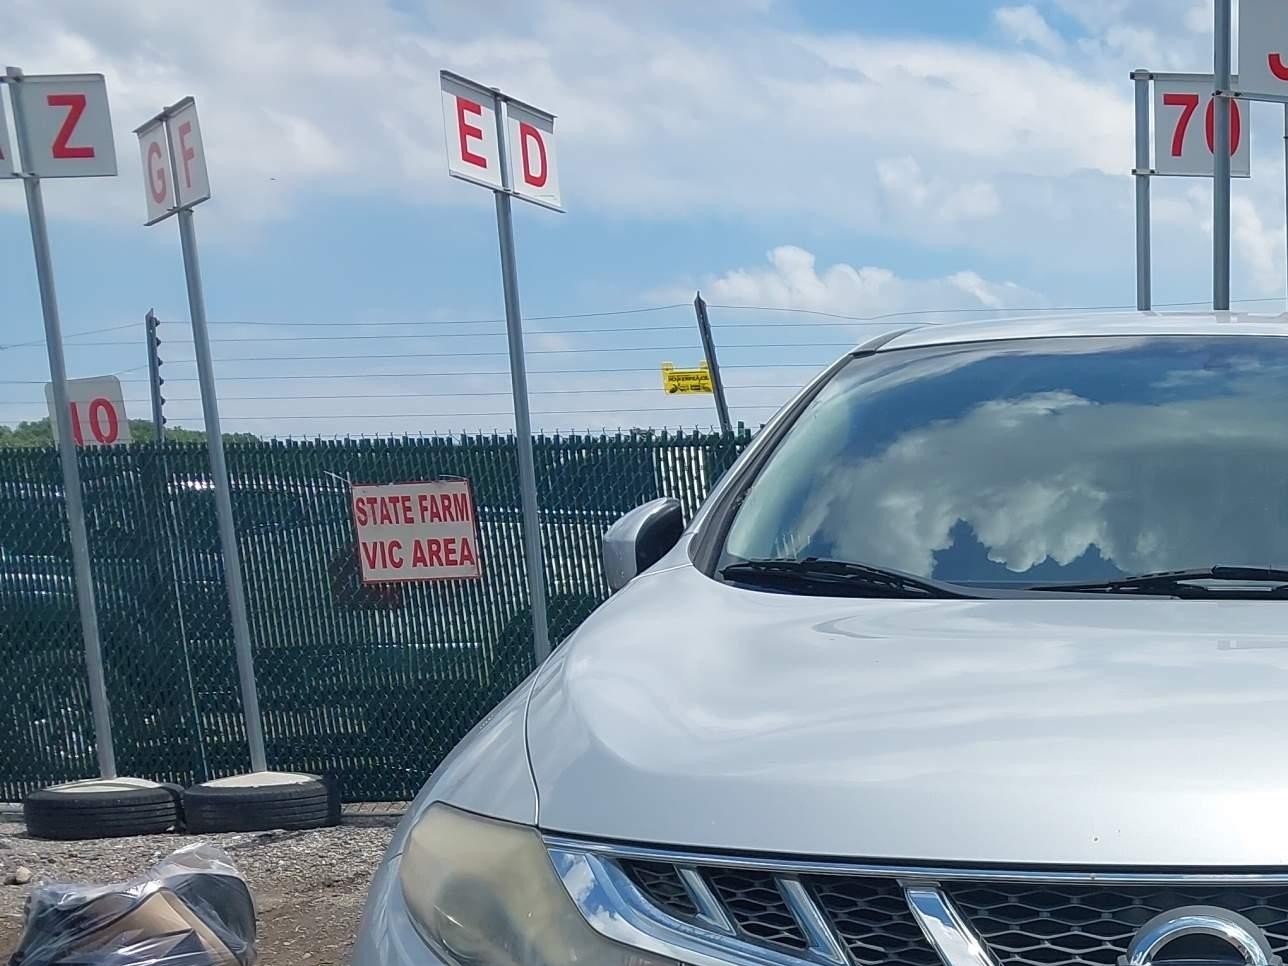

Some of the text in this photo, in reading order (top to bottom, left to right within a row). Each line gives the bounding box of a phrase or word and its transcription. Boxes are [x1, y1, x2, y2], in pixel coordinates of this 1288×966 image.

[47, 94, 95, 158] Z
[179, 121, 195, 189] F
[456, 96, 487, 168] E
[520, 120, 547, 188] D
[1163, 94, 1240, 157] 70
[148, 141, 167, 204] G
[356, 493, 470, 526] STATE FARM
[362, 537, 475, 569] VIC AREA
